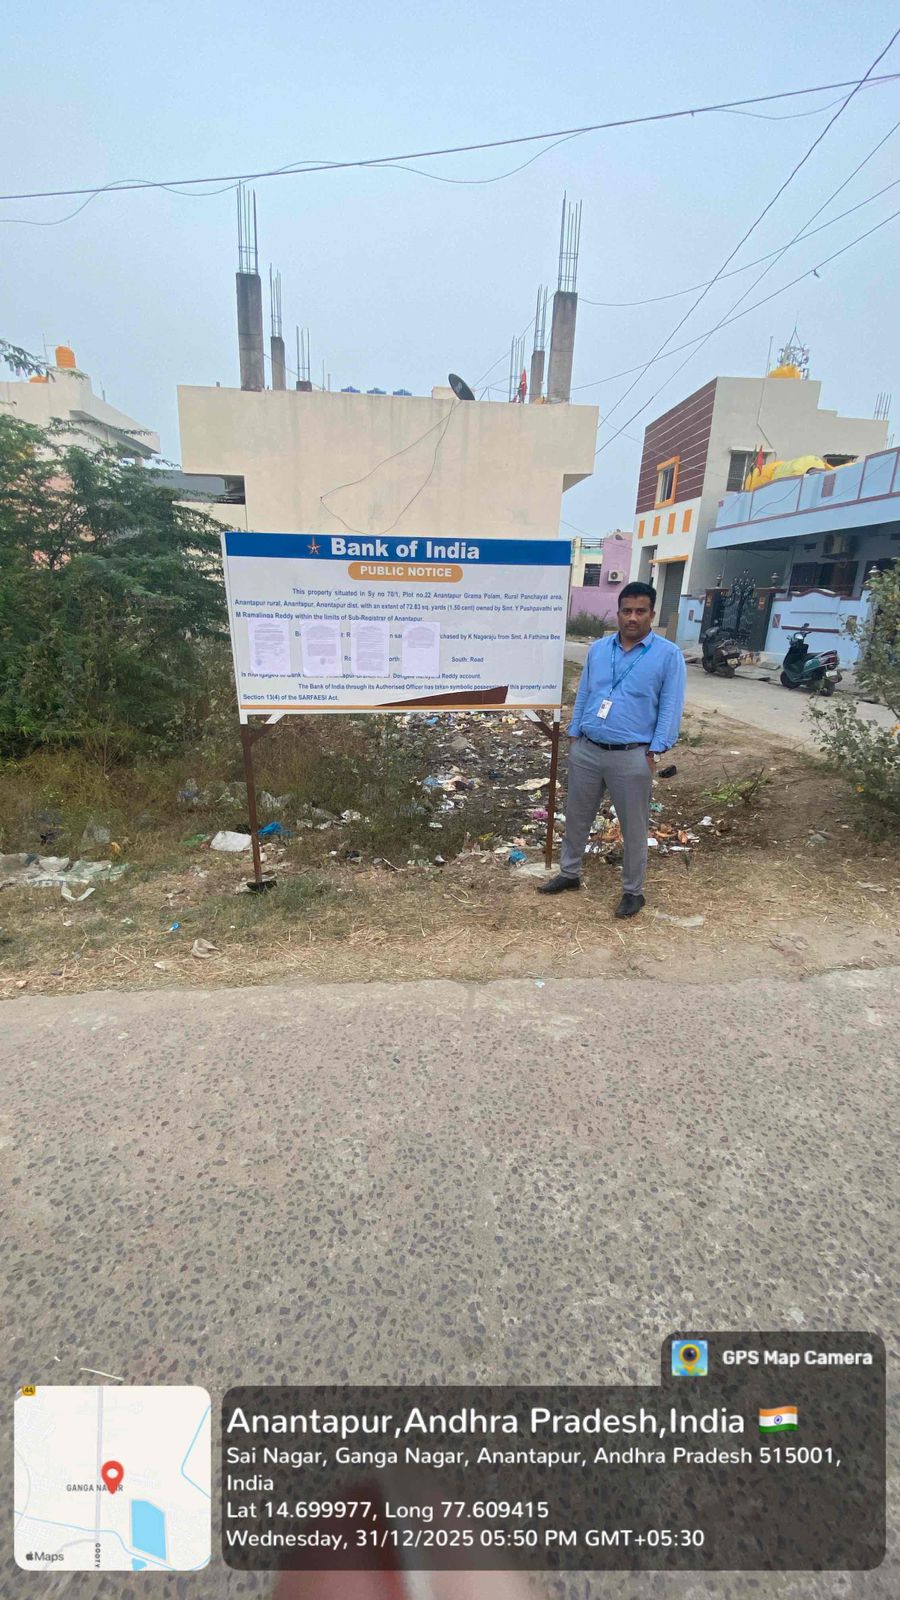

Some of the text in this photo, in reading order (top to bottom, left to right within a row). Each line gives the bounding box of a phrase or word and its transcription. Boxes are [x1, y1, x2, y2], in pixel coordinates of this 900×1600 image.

[331, 537, 480, 560] Bank of India
[360, 565, 452, 577] PUBLIC NOTICE
[368, 590, 375, 598] Sy
[235, 599, 265, 607] Anantapur
